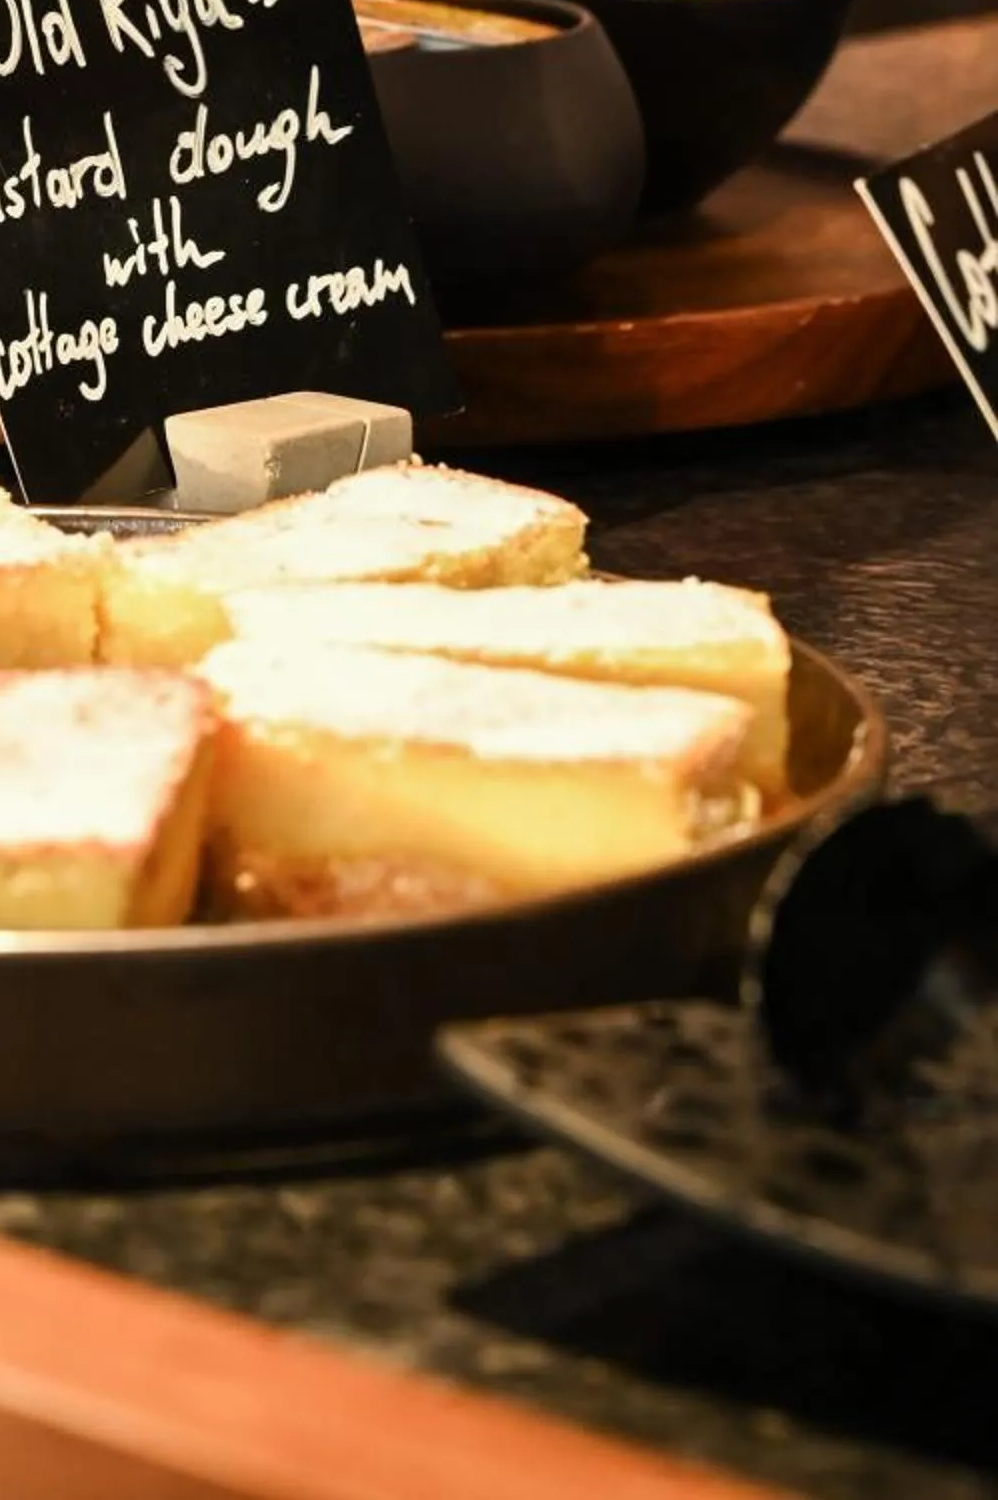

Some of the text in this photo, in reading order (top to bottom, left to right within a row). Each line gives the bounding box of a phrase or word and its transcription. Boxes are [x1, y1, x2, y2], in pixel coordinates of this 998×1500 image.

[170, 64, 354, 212] dough
[102, 197, 225, 287] with
[143, 280, 268, 357] cheese
[286, 258, 416, 319] cream
